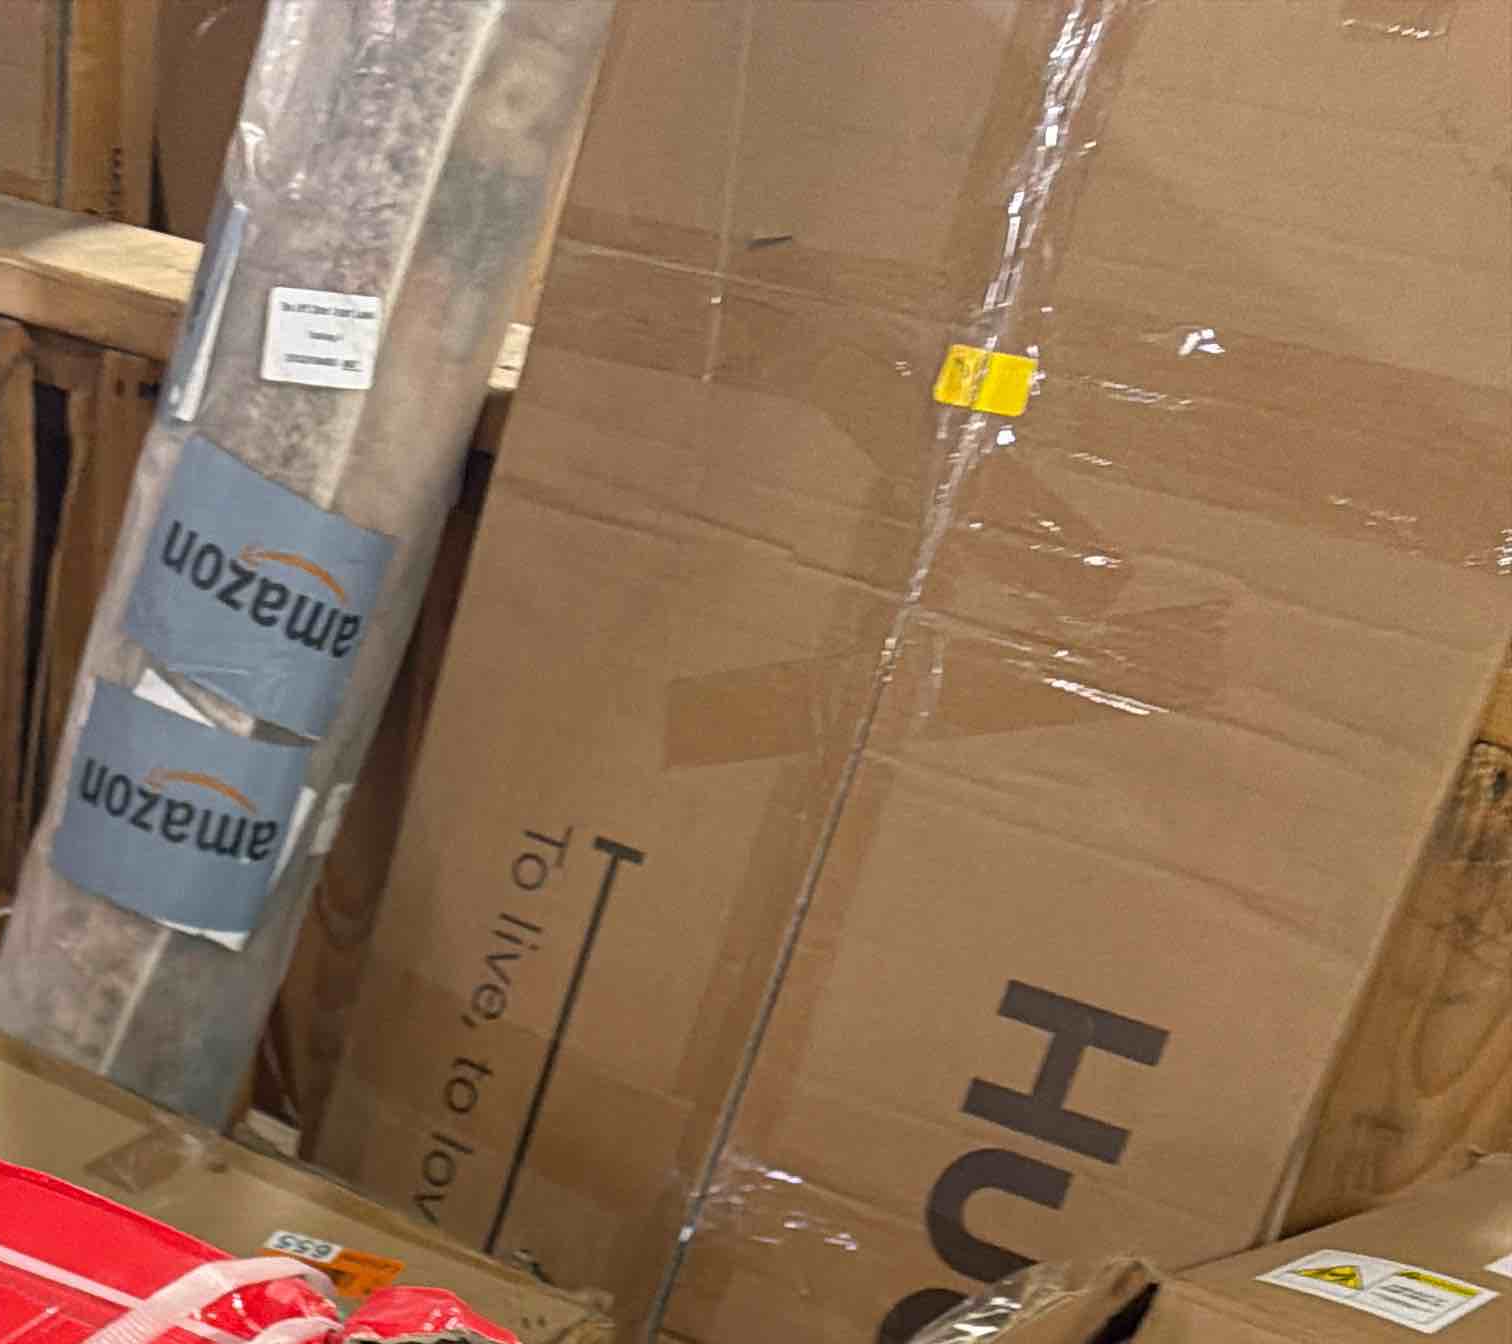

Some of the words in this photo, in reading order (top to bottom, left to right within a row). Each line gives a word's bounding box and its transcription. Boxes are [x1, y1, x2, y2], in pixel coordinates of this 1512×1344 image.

[159, 520, 362, 660] amazon
[79, 757, 281, 863] amazon
[511, 825, 574, 891] To
[459, 912, 544, 1030] live,
[443, 1056, 494, 1114] to
